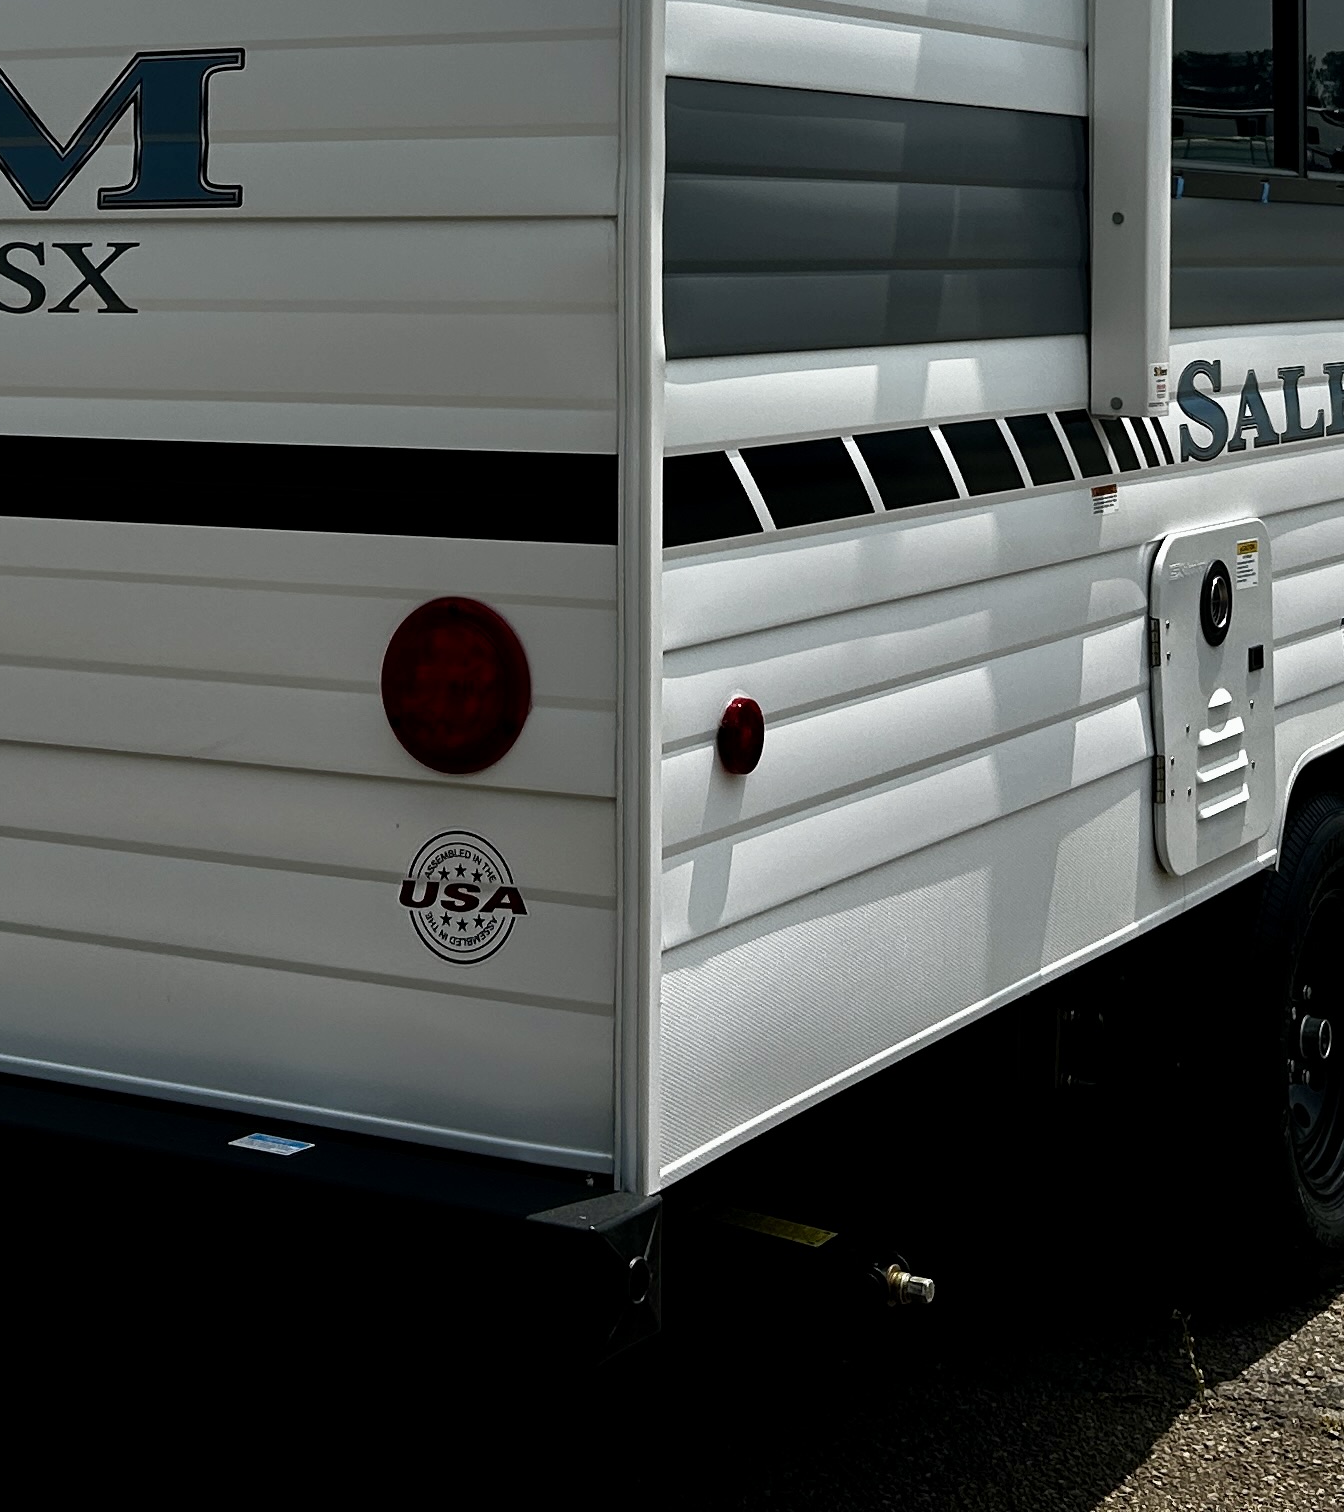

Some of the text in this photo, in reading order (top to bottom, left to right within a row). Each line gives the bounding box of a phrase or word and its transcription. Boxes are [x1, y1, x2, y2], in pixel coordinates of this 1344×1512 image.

[424, 848, 497, 884] ASSEMBLED IN THE
[399, 879, 528, 916] USA
